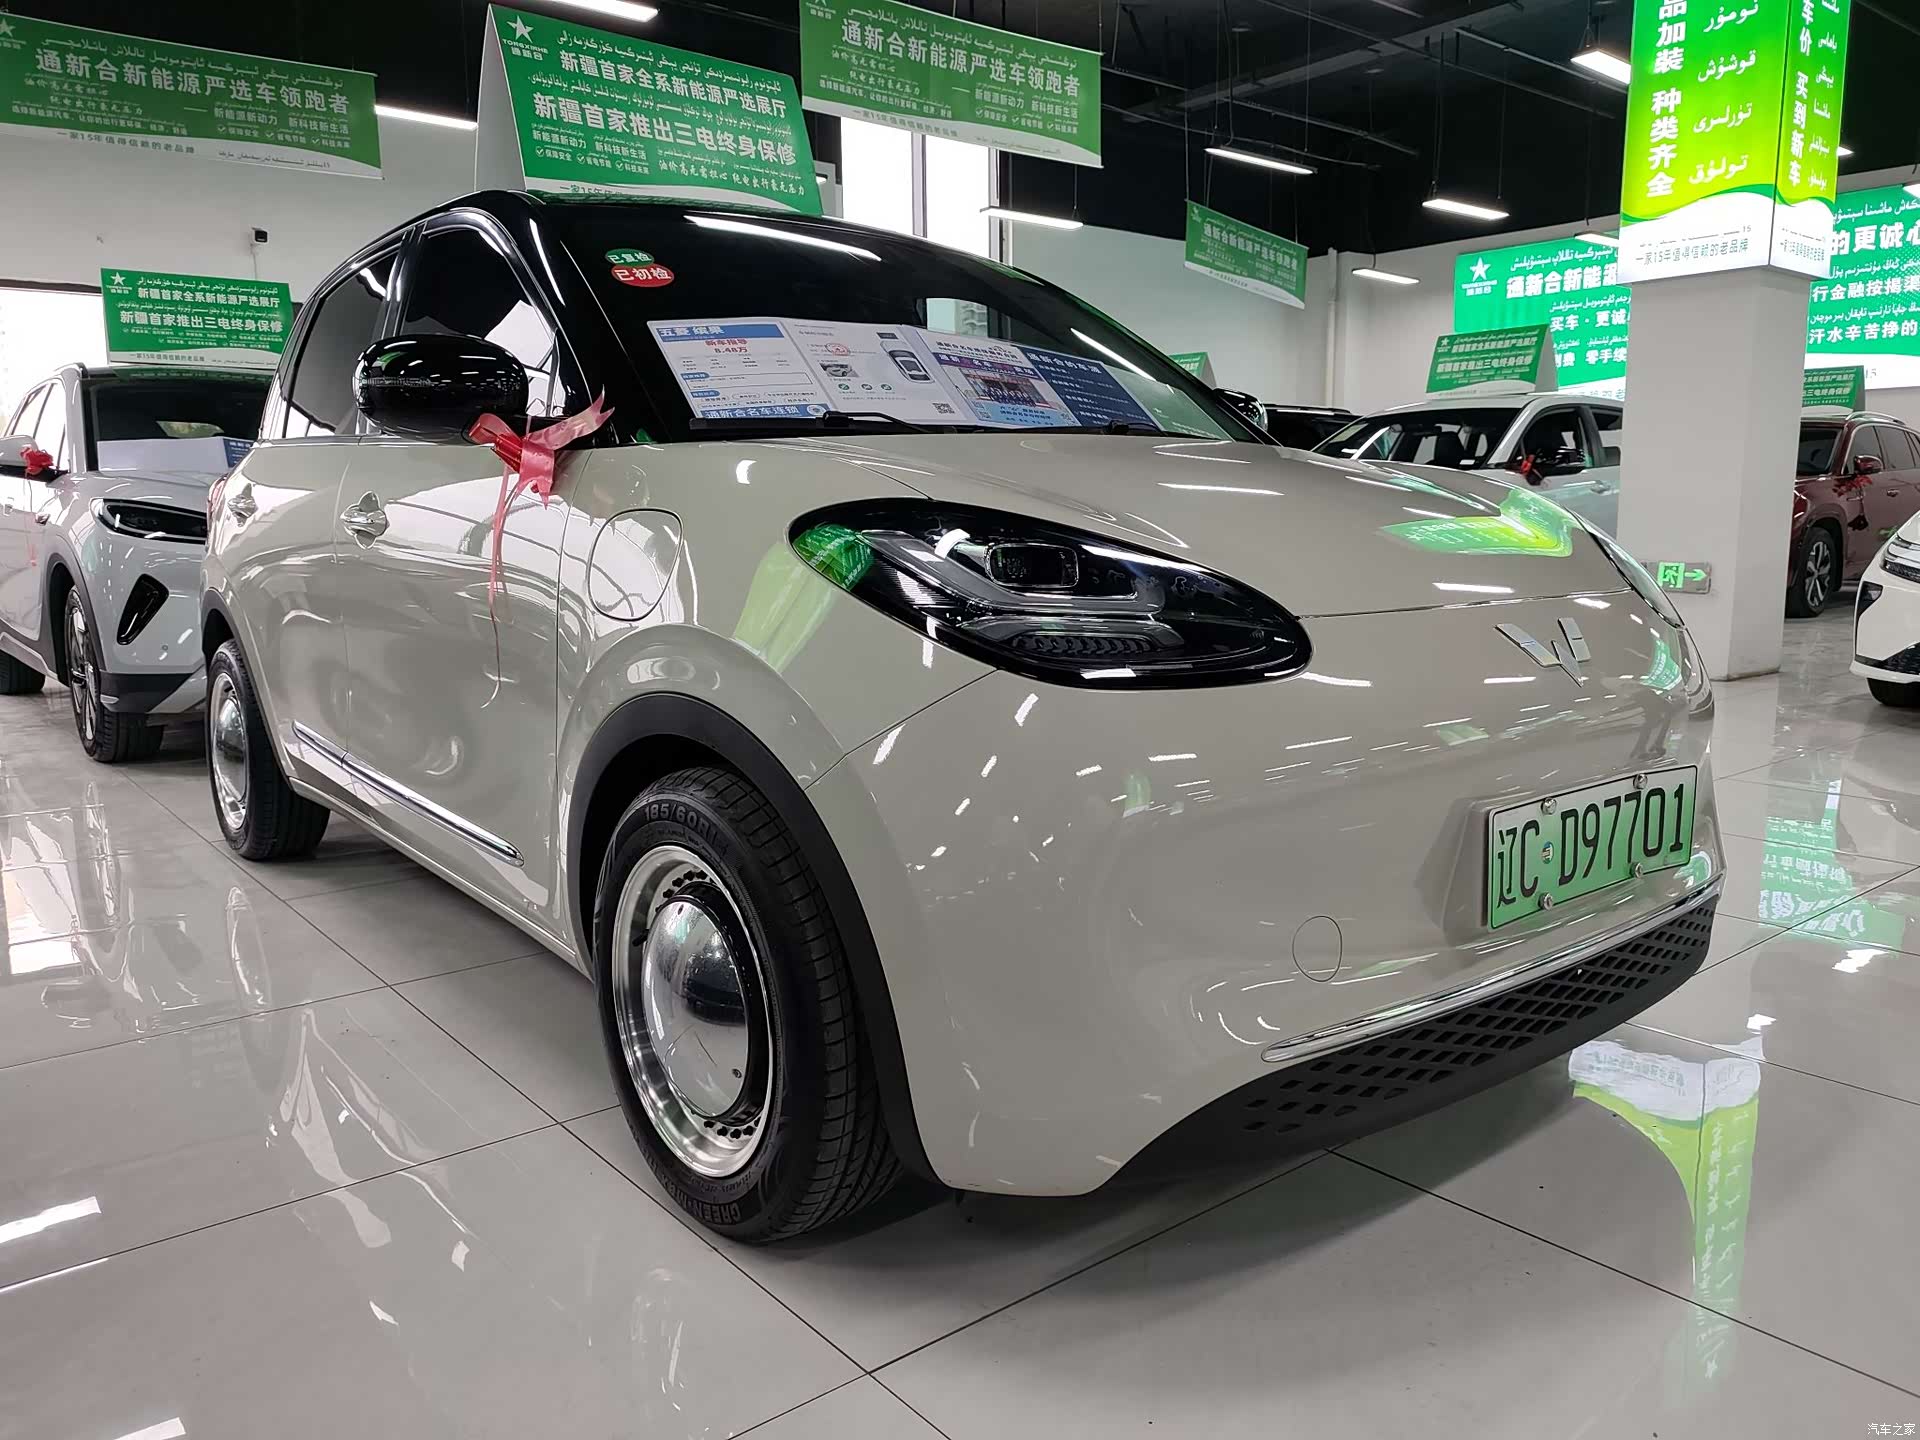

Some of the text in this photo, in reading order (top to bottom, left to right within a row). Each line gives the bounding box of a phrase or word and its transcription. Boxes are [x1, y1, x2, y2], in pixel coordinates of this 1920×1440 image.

[841, 18, 1080, 97] 通新合新能源严选车领跑者
[35, 48, 350, 114] 通新合新能源严选车领跑者
[559, 50, 787, 118] 新疆首家全系新能源严选展厅
[975, 89, 1078, 119] 新能源新动力 新科技新生活
[214, 107, 349, 134] 新能源新动力 新科技新生活
[533, 91, 797, 166] 新疆首家推出三电终身保修
[1789, 71, 1809, 187] 买到新车
[532, 130, 587, 149] 新能源新动力
[595, 142, 647, 161] 新科技新生活
[1646, 87, 1682, 198] 种类齐全
[607, 252, 652, 264] 已复检
[615, 267, 672, 281] 已初检
[1506, 263, 1618, 299] 通新合新能源
[137, 287, 280, 308] 新疆首家全系新能源严选展厅
[119, 310, 283, 333] 新疆首家推出三电终身保修
[659, 327, 691, 337] 五菱
[1808, 319, 1918, 345] 汗水辛苦挣的
